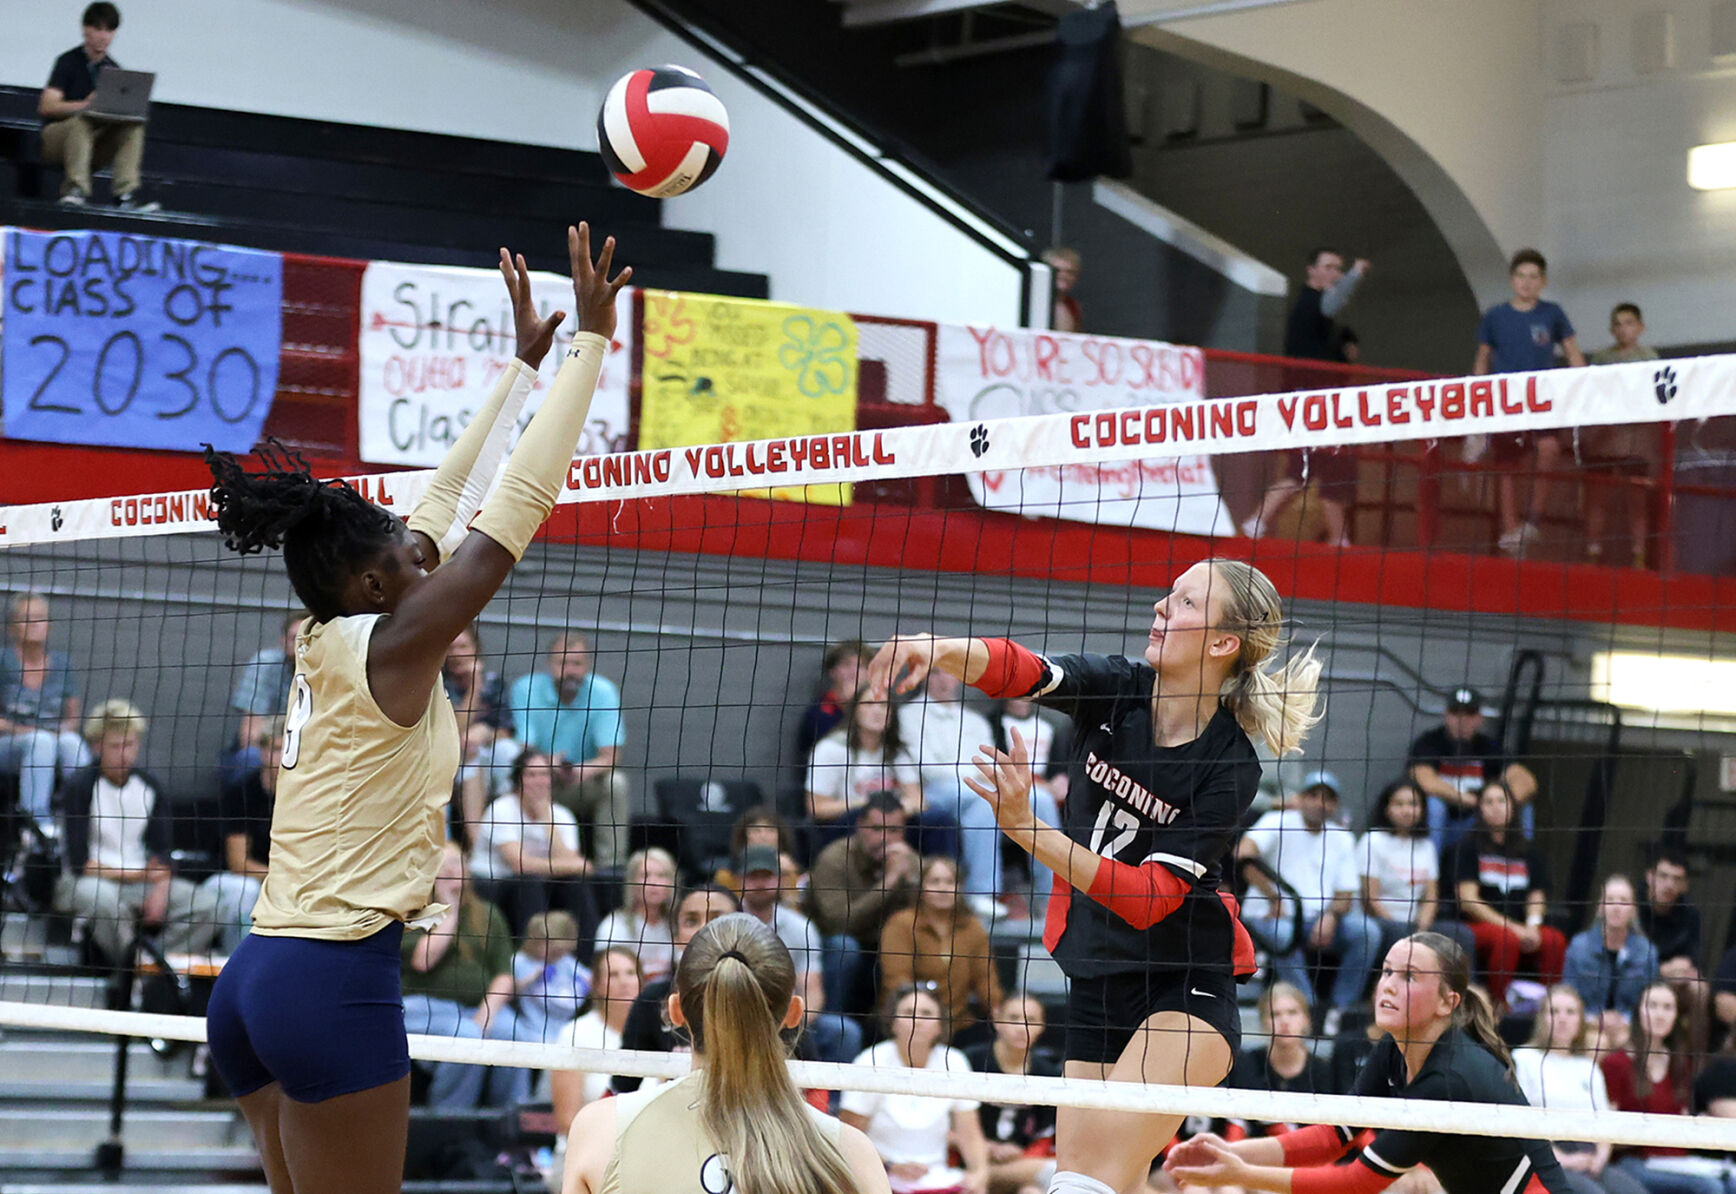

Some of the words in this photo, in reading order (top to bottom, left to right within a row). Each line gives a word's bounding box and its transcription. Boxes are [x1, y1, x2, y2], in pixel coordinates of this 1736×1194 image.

[164, 282, 233, 327] OF
[29, 330, 260, 423] 2030
[388, 398, 477, 451] Clas
[1070, 401, 1258, 448] COCONINO
[1277, 377, 1552, 432] VOLLEYBALL
[566, 450, 671, 490] CONINO
[684, 433, 896, 479] VOLLEYBALL
[1089, 799, 1141, 860] 12
